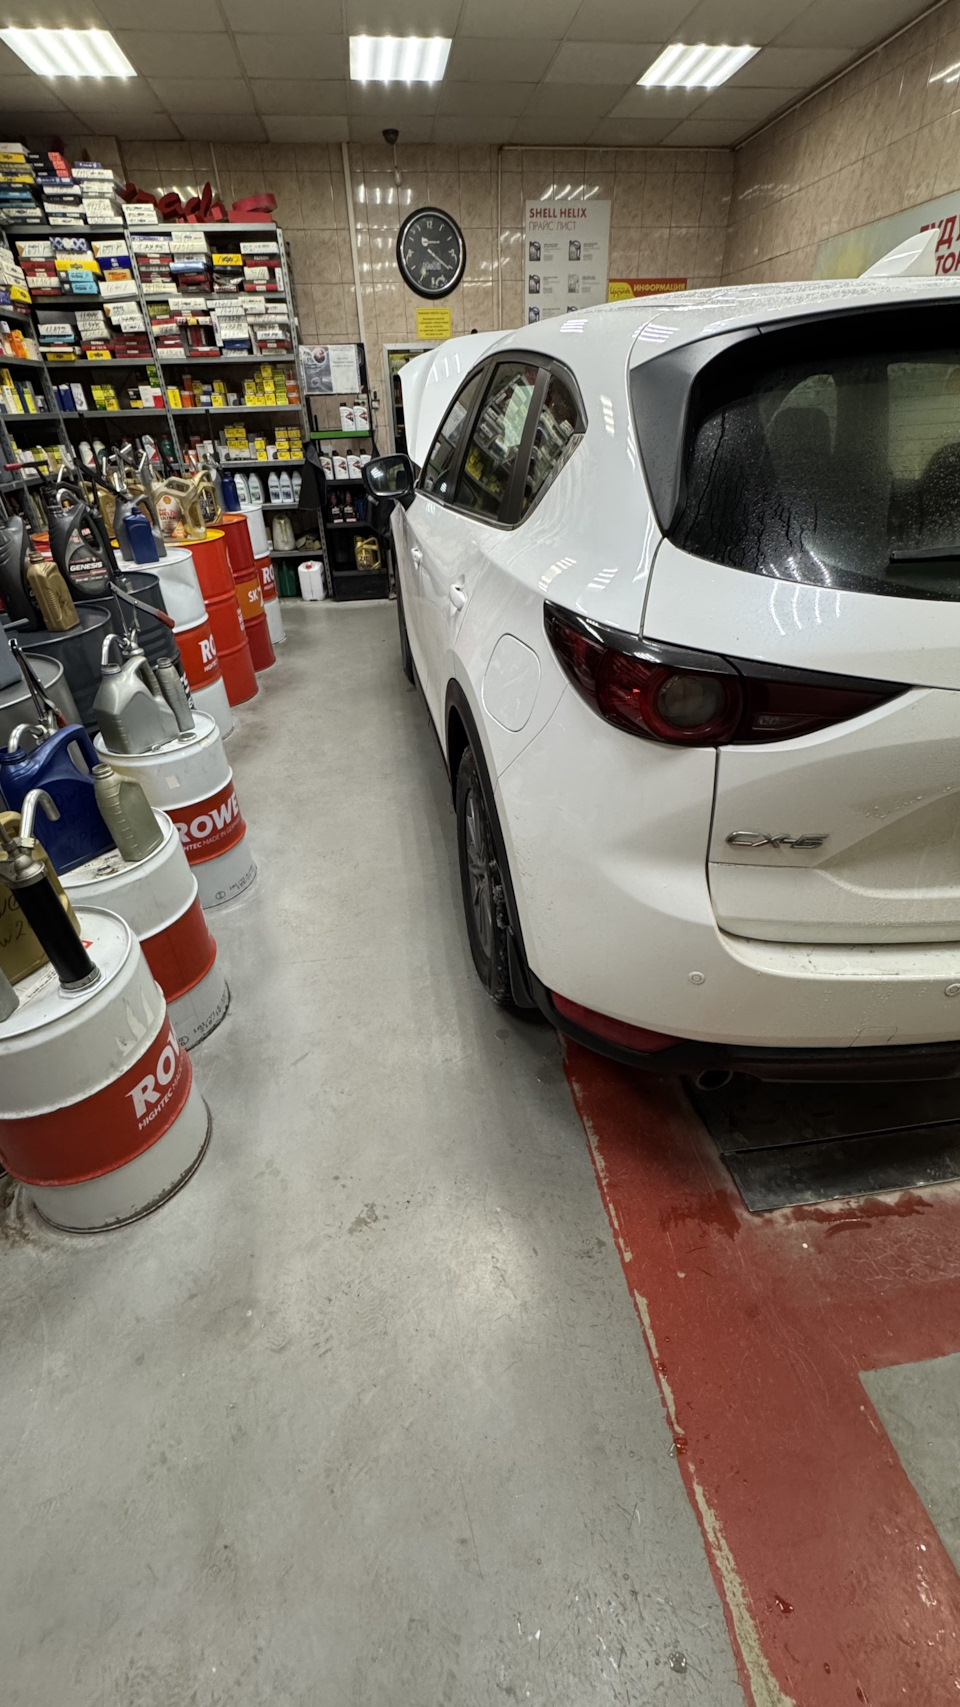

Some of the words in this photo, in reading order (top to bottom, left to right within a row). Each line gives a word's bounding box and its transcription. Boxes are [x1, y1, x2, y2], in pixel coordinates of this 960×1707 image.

[529, 208, 557, 218] SHELL
[559, 208, 587, 218] HELIX
[529, 220, 554, 231] ПРАЙС
[556, 221, 577, 231] ЛИСТ
[633, 283, 686, 292] ИНФОРМАЦИЯ
[70, 561, 103, 572] GENESIS
[176, 791, 240, 844] ROWE
[725, 830, 830, 849] CX-5
[183, 841, 203, 852] HTEC
[138, 1087, 173, 1131] HIGHTEC
